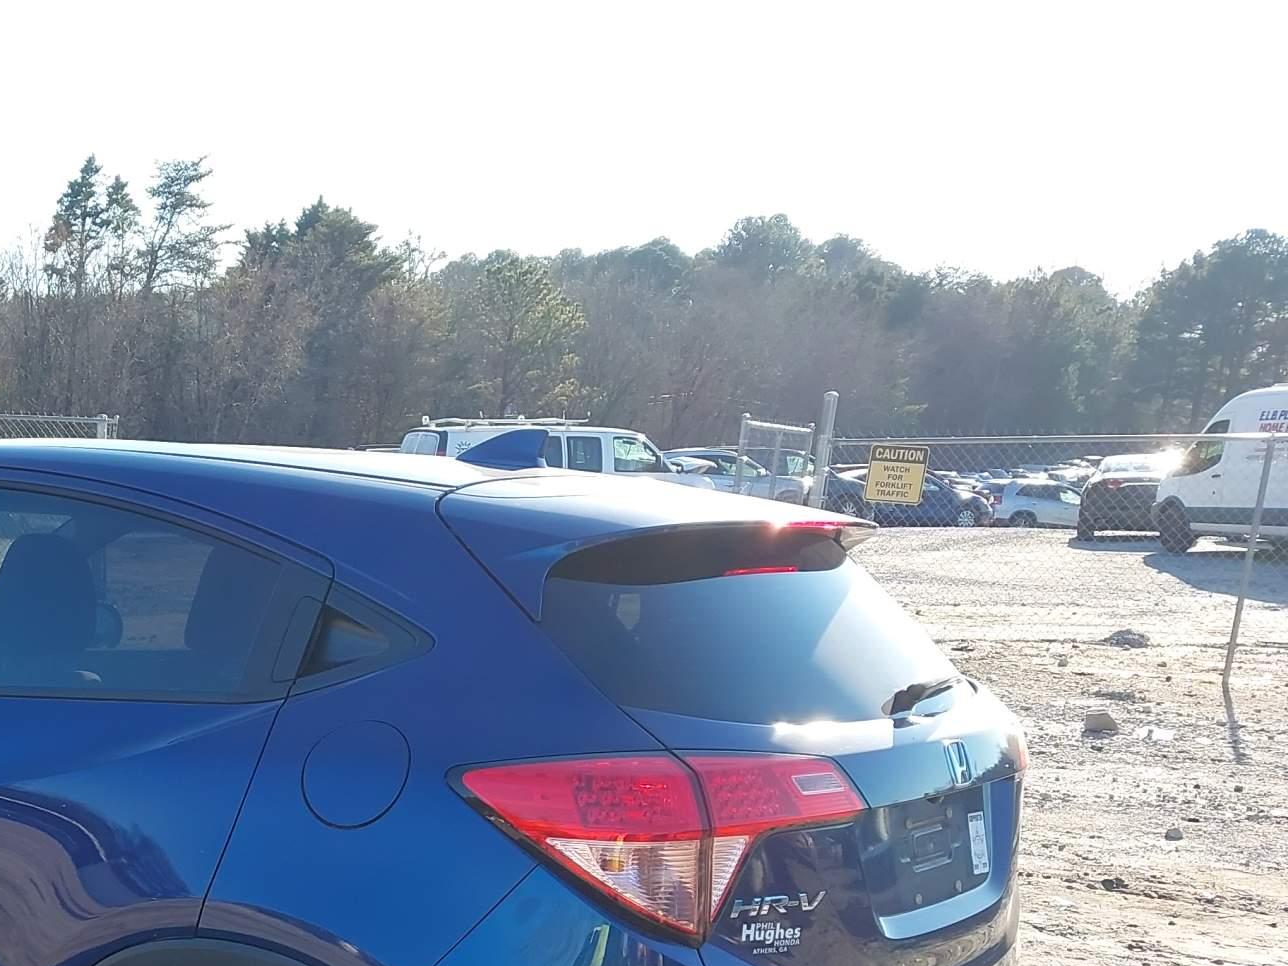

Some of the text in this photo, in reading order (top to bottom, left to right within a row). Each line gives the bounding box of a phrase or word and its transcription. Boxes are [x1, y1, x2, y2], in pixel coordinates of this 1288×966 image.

[875, 448, 925, 462] CAUTION
[883, 465, 911, 473] WATCH
[887, 473, 904, 481] FOR
[875, 481, 913, 490] FORKLIFT
[876, 489, 909, 498] TRAFFIC
[730, 890, 827, 919] HR-V
[756, 922, 776, 930] PHIL
[741, 922, 801, 944] Hughes
[774, 938, 800, 947] HONDA
